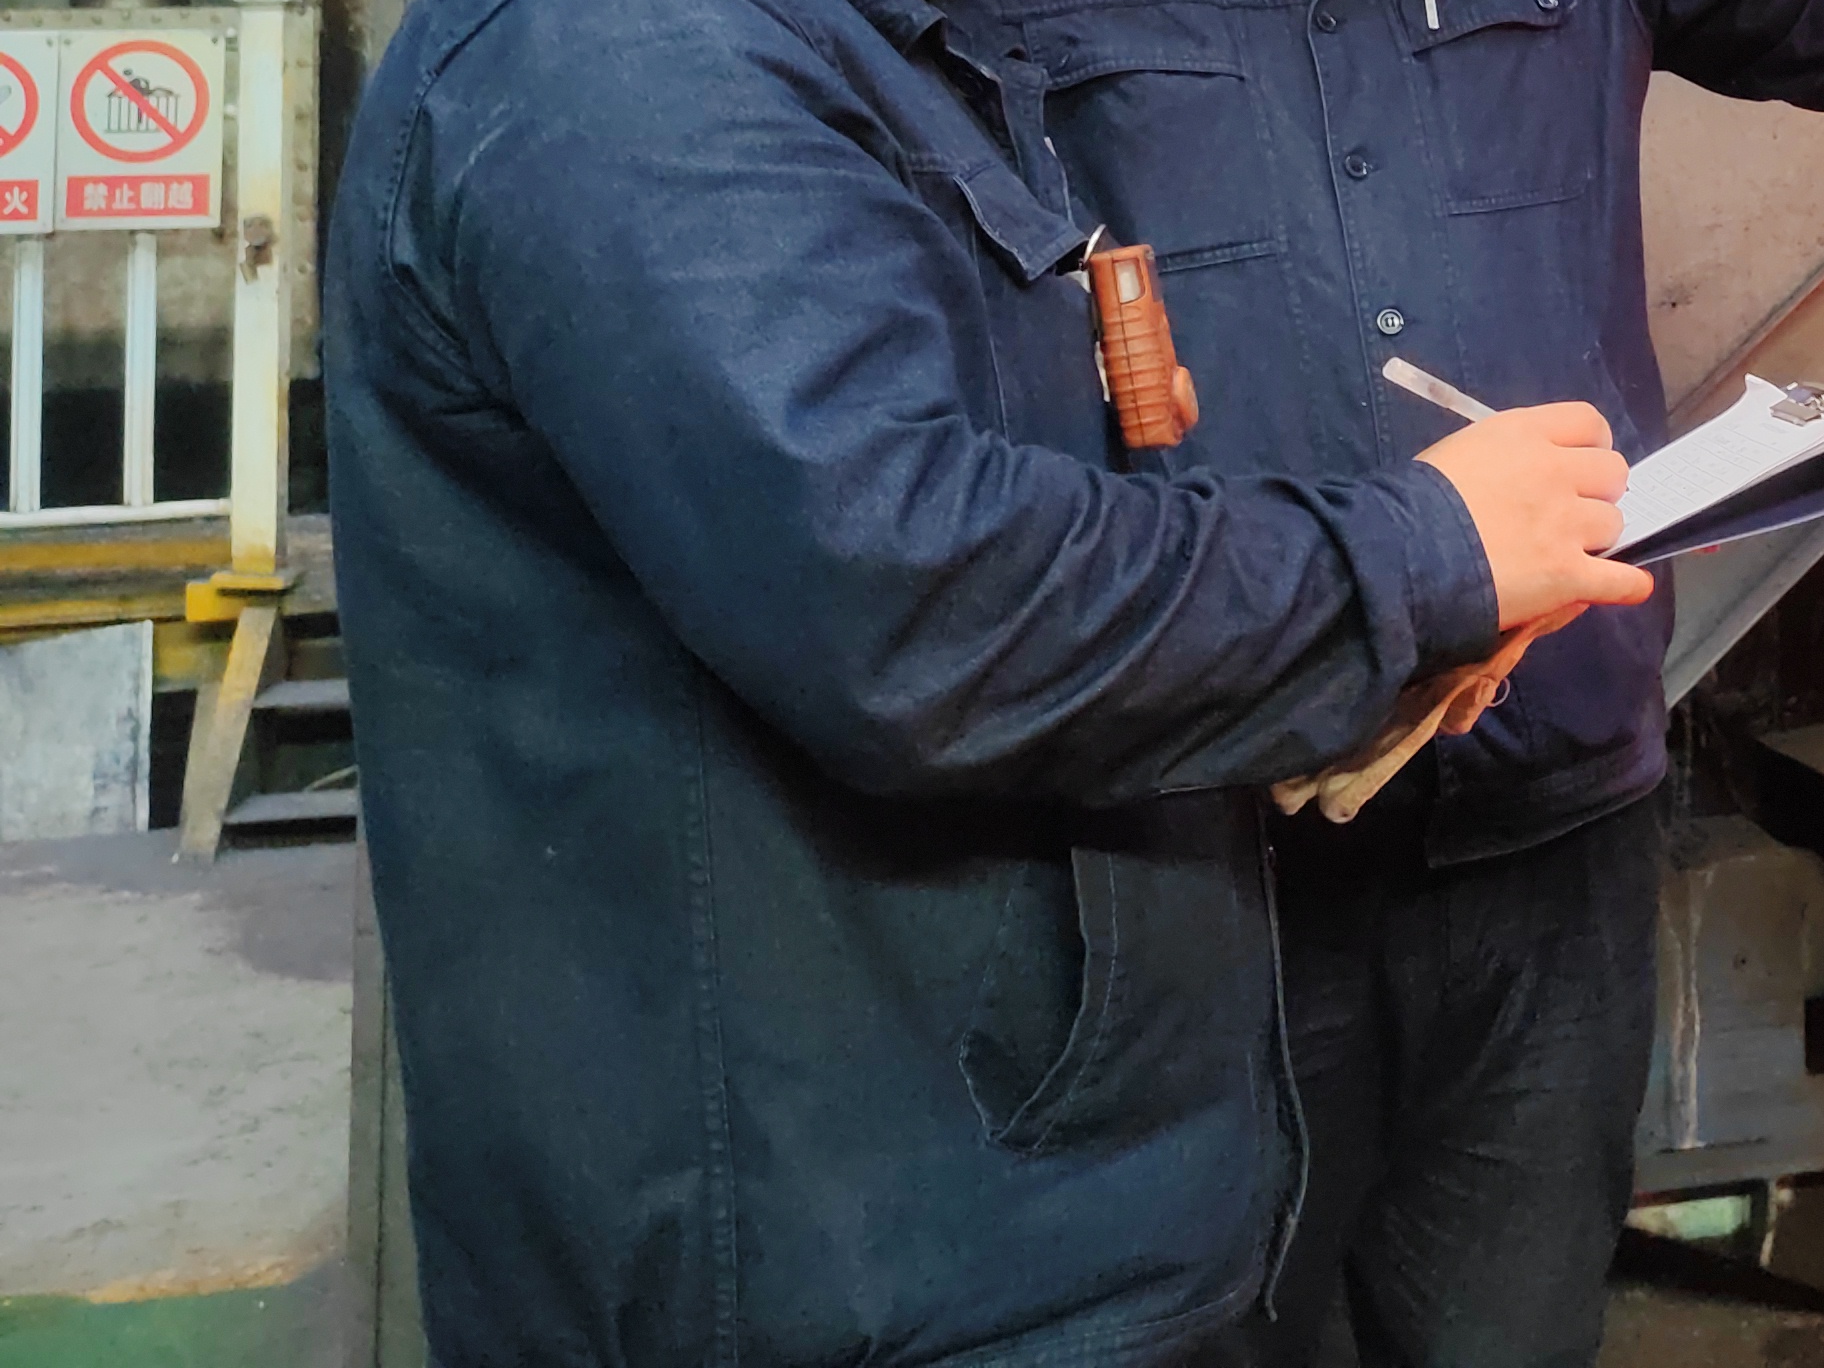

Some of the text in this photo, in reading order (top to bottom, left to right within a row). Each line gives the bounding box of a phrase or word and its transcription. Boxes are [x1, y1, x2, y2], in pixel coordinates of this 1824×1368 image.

[3, 186, 29, 215] 火
[83, 181, 194, 211] 禁止翻越
